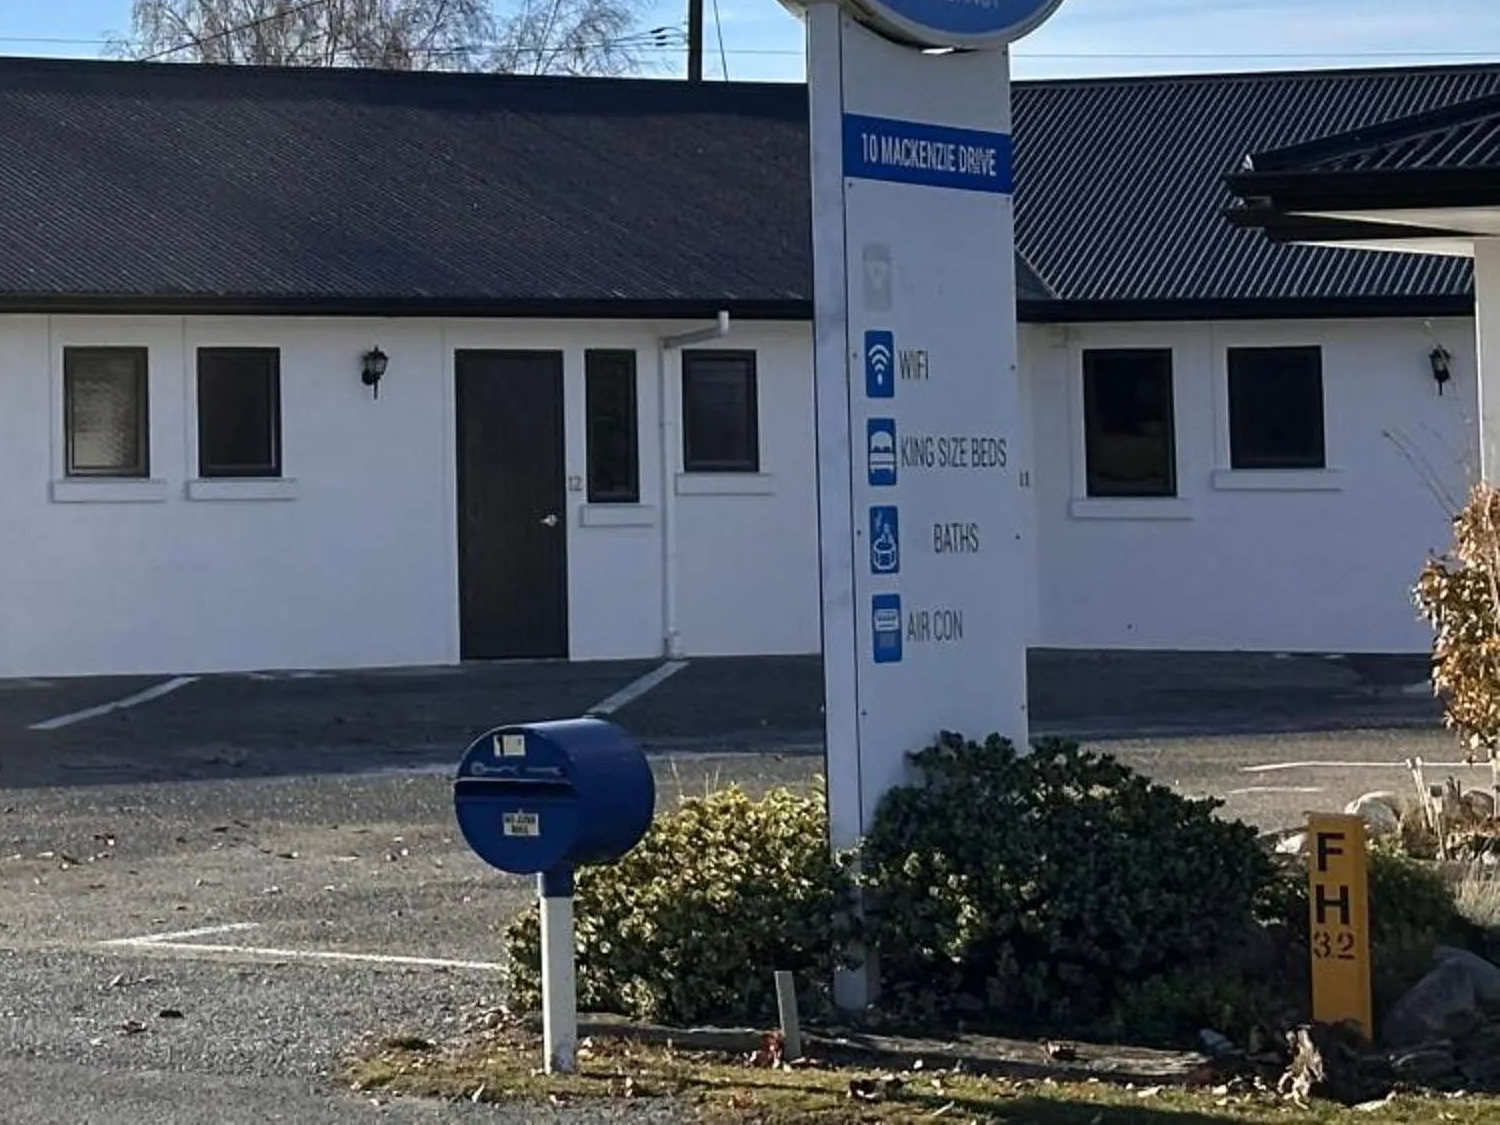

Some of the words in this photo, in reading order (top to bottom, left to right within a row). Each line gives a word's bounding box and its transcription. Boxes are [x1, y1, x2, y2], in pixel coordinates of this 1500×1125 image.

[861, 132, 878, 164] 10
[881, 137, 956, 173] MACKENZIE
[959, 145, 997, 176] DRIVE
[899, 350, 929, 380] WIFI
[901, 436, 934, 468] KING
[938, 436, 968, 468] SIZE
[971, 437, 1007, 468] BEDS
[568, 475, 583, 491] 12
[933, 522, 979, 554] BATHS
[906, 610, 930, 641] AIR
[933, 610, 963, 641] CON
